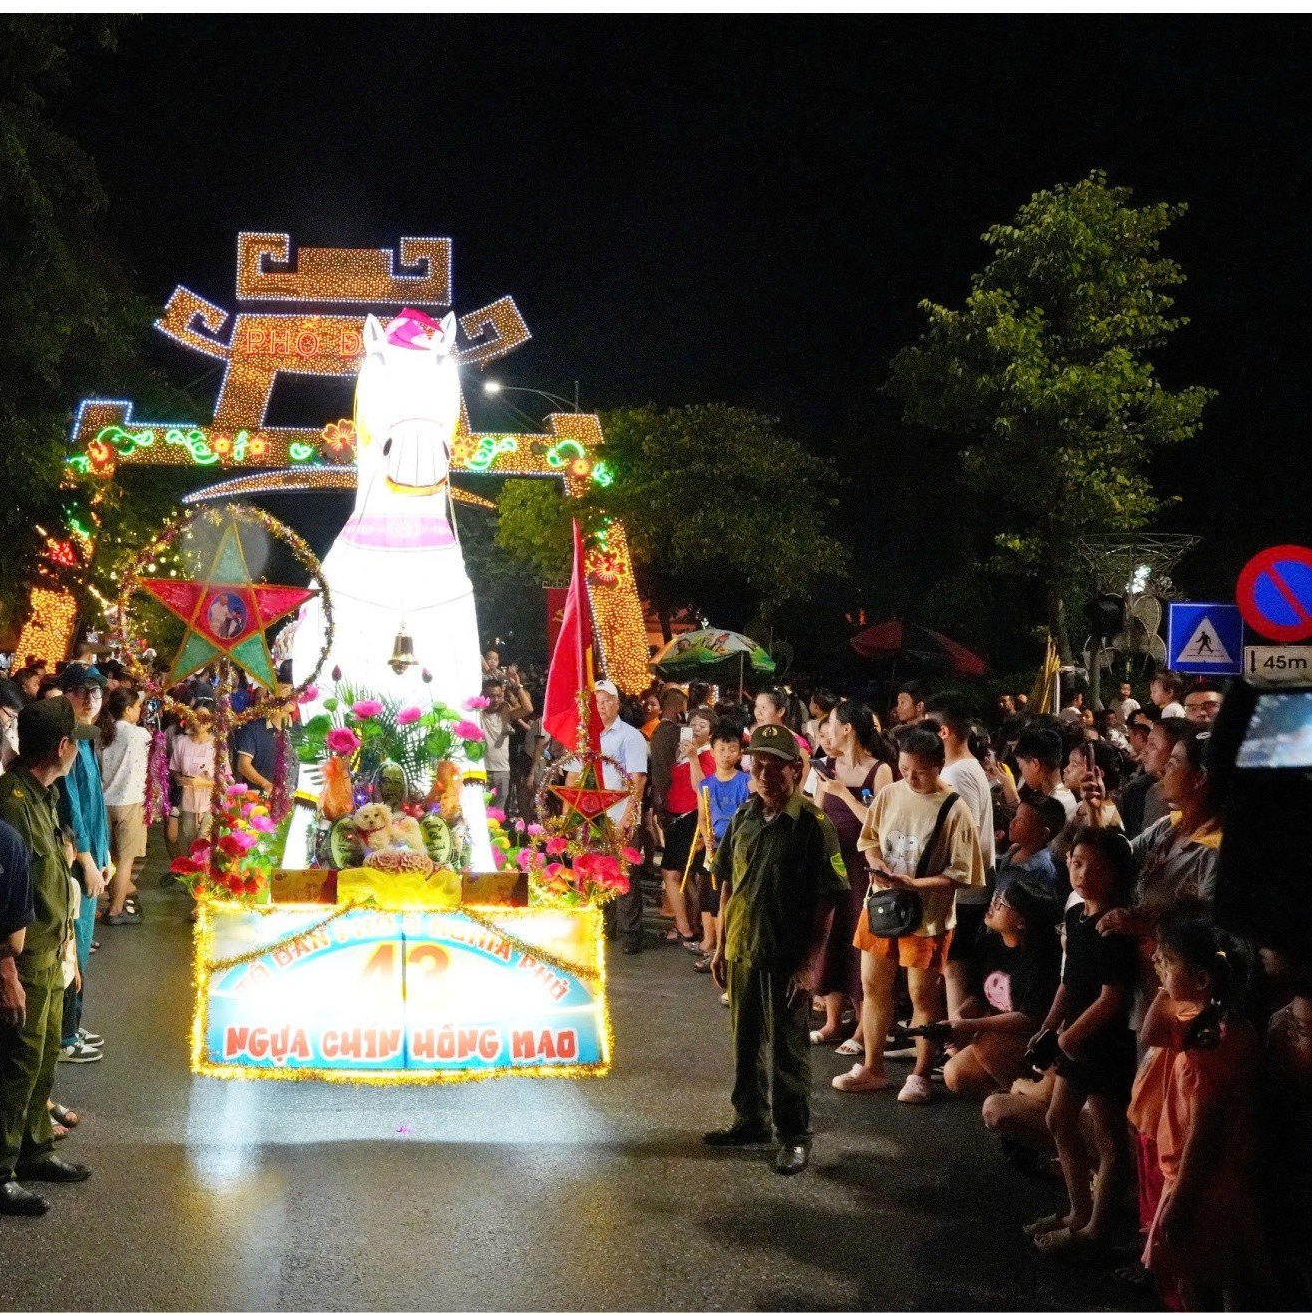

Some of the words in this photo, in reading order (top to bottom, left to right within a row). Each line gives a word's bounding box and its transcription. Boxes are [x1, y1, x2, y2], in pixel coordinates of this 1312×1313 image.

[339, 329, 362, 356] Đ
[1264, 655, 1307, 669] 45m
[227, 1025, 310, 1062] NGỰA
[321, 1023, 400, 1059] CHÍN
[412, 1023, 499, 1059] HỒNG
[512, 1029, 576, 1059] MAO
